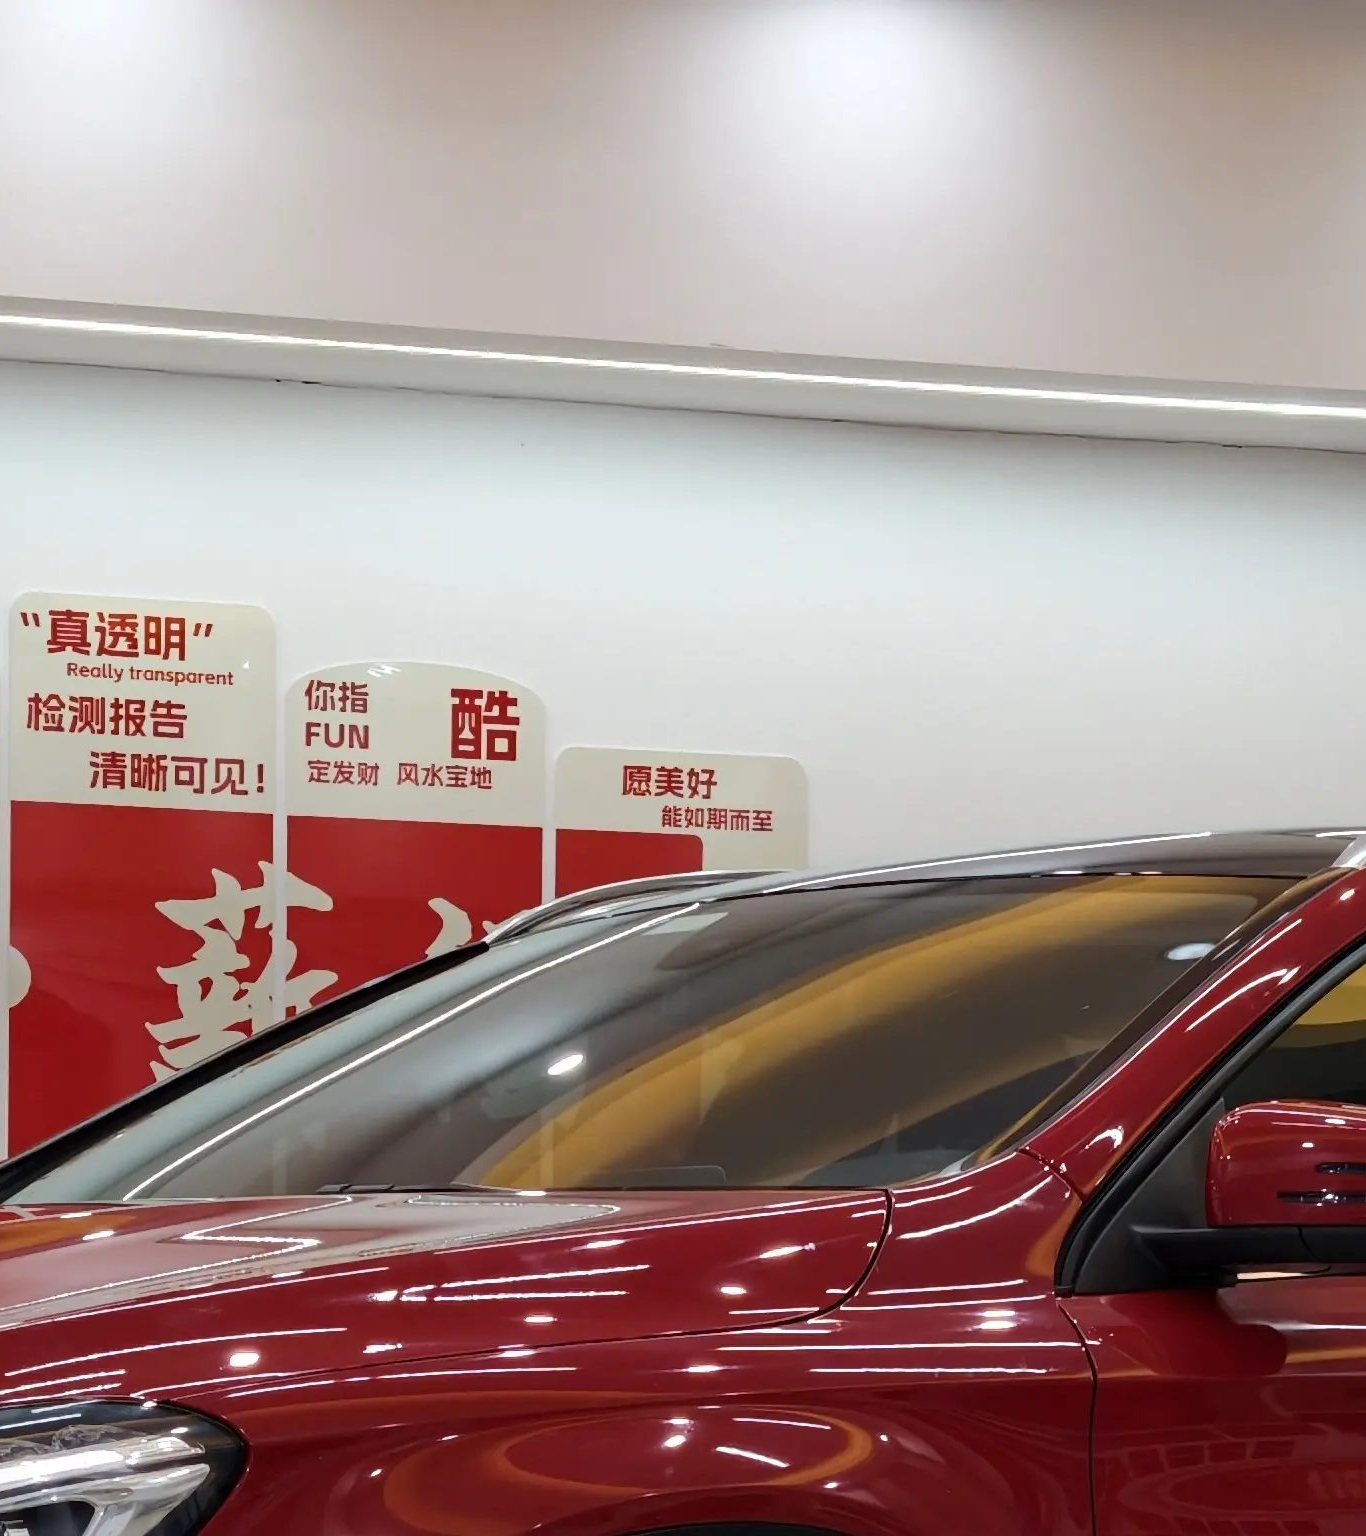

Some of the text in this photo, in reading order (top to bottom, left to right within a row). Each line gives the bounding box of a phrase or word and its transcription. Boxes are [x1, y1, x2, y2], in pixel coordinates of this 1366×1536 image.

[20, 607, 214, 662] “真透明”
[66, 661, 235, 687] Really transparent
[304, 679, 369, 715] 你指
[26, 691, 188, 740] 检测报告
[449, 687, 521, 762] 酷
[304, 721, 370, 750] FUN
[307, 758, 494, 790] 定发财 风水宝地
[621, 764, 718, 800] 愿美好
[660, 804, 774, 833] 能如期而至
